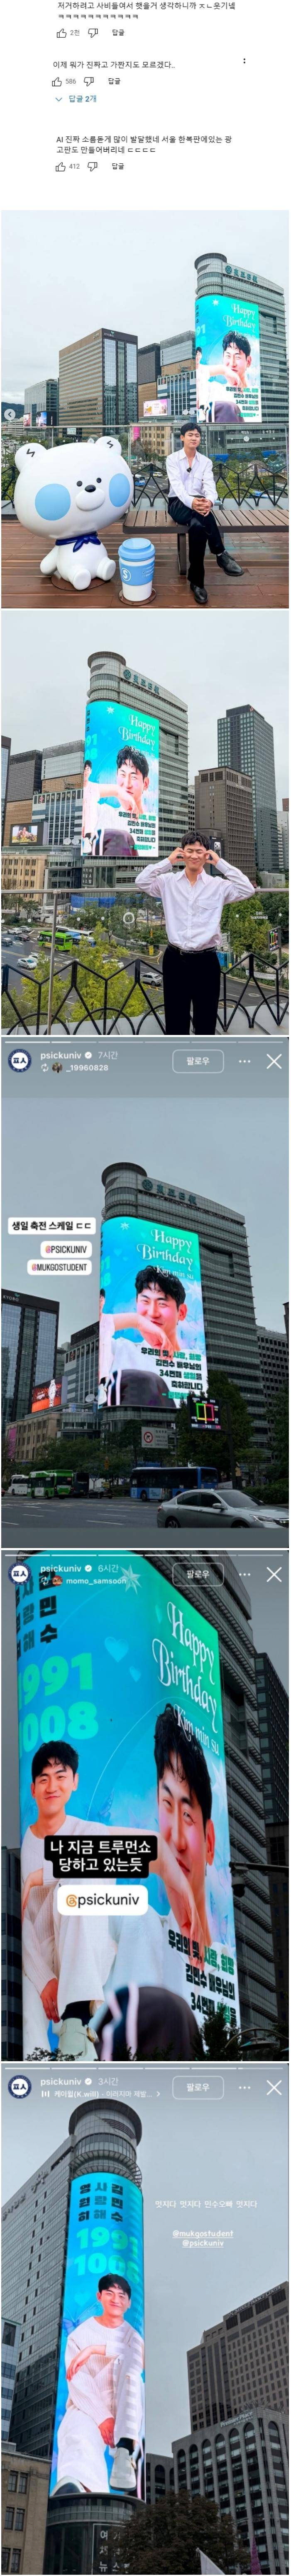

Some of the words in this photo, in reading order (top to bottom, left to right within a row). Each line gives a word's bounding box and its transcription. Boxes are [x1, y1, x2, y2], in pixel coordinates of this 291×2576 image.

[231, 303, 255, 320] Happy
[223, 315, 256, 333] Birthday
[123, 569, 128, 579] S
[129, 714, 155, 737] Happy
[118, 726, 155, 751] Birthday
[129, 745, 141, 756] Kim
[151, 1229, 192, 1254] Happy
[137, 1243, 193, 1271] Birthday
[153, 1265, 171, 1277] Kim
[141, 1347, 161, 1356] 우리의
[173, 1351, 188, 1360] 사랑,
[156, 1359, 175, 1367] 김민수
[176, 1361, 202, 1371] 배우님의
[159, 1369, 181, 1378] 34번째
[183, 1372, 202, 1380] 생일을
[171, 1381, 203, 1390] 축하합니다
[167, 1601, 215, 1685] Happy
[152, 1638, 218, 1733] Birthday
[174, 1704, 193, 1742] Kim
[196, 1725, 210, 1748] min
[211, 1739, 219, 1756] su
[168, 1929, 191, 1956] 우리의
[204, 1945, 220, 1972] 사랑,
[221, 1953, 234, 1975] 희망
[186, 1963, 207, 1989] 김민수
[208, 1973, 235, 2001] 배우님의
[76, 2226, 138, 2259] 1991
[74, 2252, 140, 2285] 1008
[248, 2295, 265, 2306] FINANCE
[266, 2285, 282, 2296] CENTER
[220, 2417, 239, 2427] Premier
